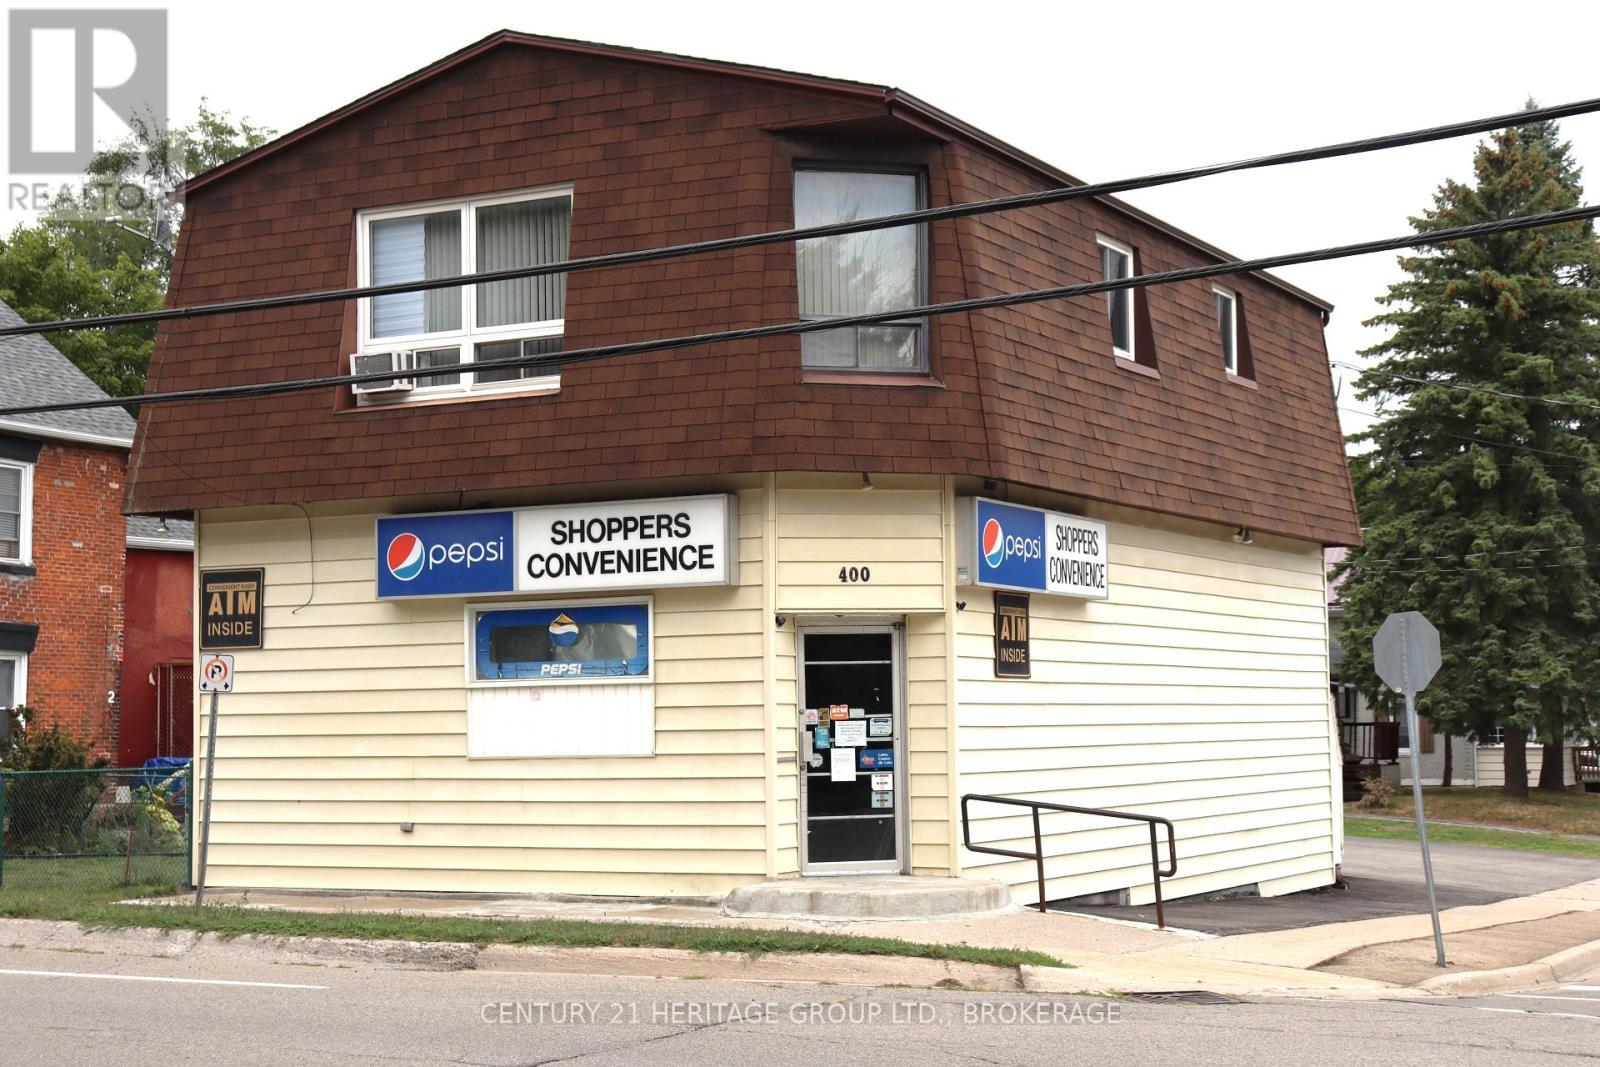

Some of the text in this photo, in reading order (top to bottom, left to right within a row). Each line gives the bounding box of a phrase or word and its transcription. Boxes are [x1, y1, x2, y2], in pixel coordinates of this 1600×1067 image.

[550, 511, 691, 546] SHOPPERS
[1056, 524, 1099, 557] SHOPPERS
[428, 536, 504, 571] pepsi
[527, 544, 715, 579] CONVENIENCE
[1005, 535, 1041, 563] pepsi
[838, 566, 871, 583] 400
[1049, 556, 1105, 589] CONVENIENCE
[208, 591, 256, 616] ATM
[207, 621, 254, 636] INSIDE
[1000, 616, 1027, 641] ATM
[1000, 648, 1026, 663] INSIDE
[540, 663, 582, 676] PEPSI
[107, 690, 115, 704] 2
